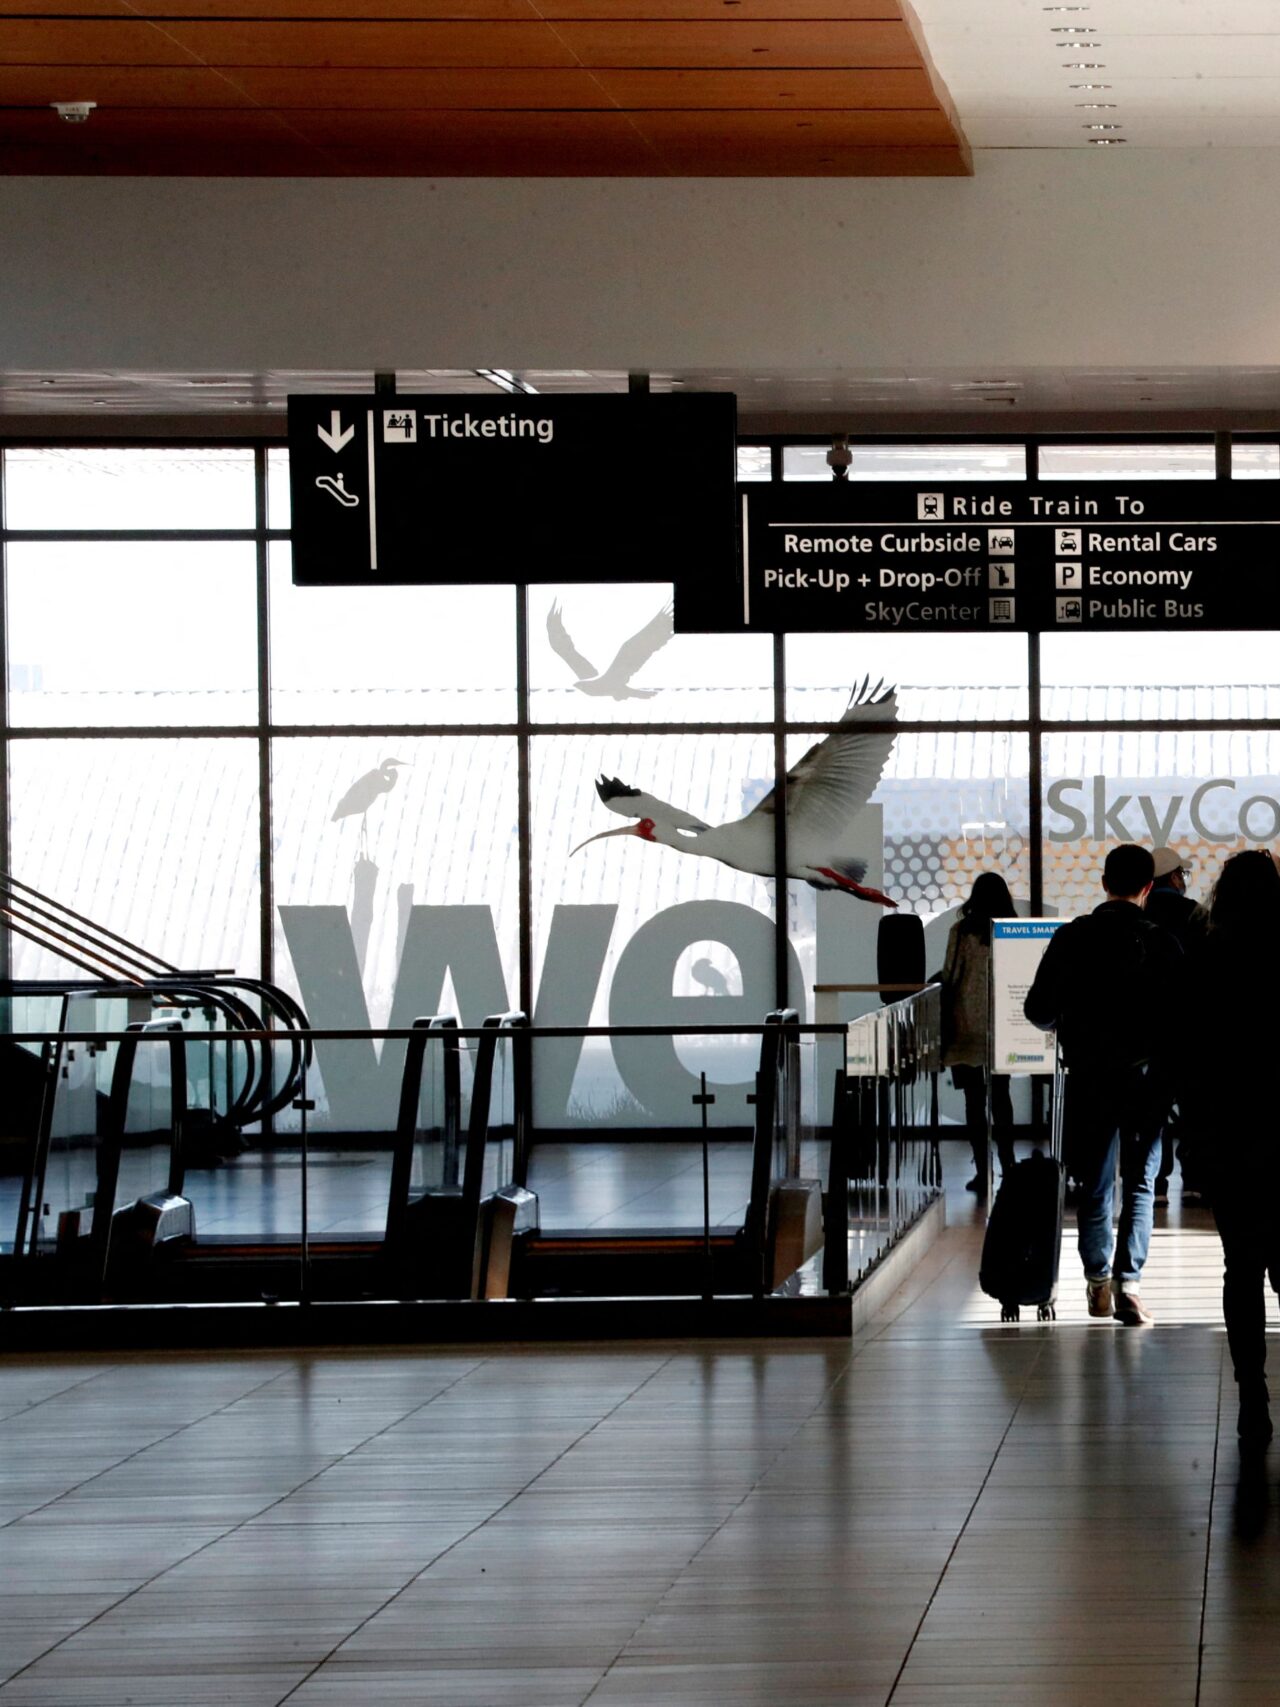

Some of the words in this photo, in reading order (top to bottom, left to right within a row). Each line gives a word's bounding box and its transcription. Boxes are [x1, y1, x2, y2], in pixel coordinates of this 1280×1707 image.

[424, 413, 553, 443] Ticketing
[954, 496, 1012, 515] Ride
[1029, 496, 1097, 515] Train
[1115, 497, 1144, 514] To
[785, 534, 872, 553] Remote
[881, 532, 980, 552] Curbside
[1089, 532, 1160, 551] Rental
[1169, 533, 1217, 551] Cars
[765, 568, 849, 592] Pick-Up
[858, 574, 871, 587] +
[880, 568, 980, 592] Drop-Off
[1090, 567, 1192, 589] Economy
[865, 601, 979, 625] SkyCenter
[1090, 599, 1156, 618] Public
[1165, 600, 1203, 617] Bus
[1002, 926, 1031, 934] TRAVEL
